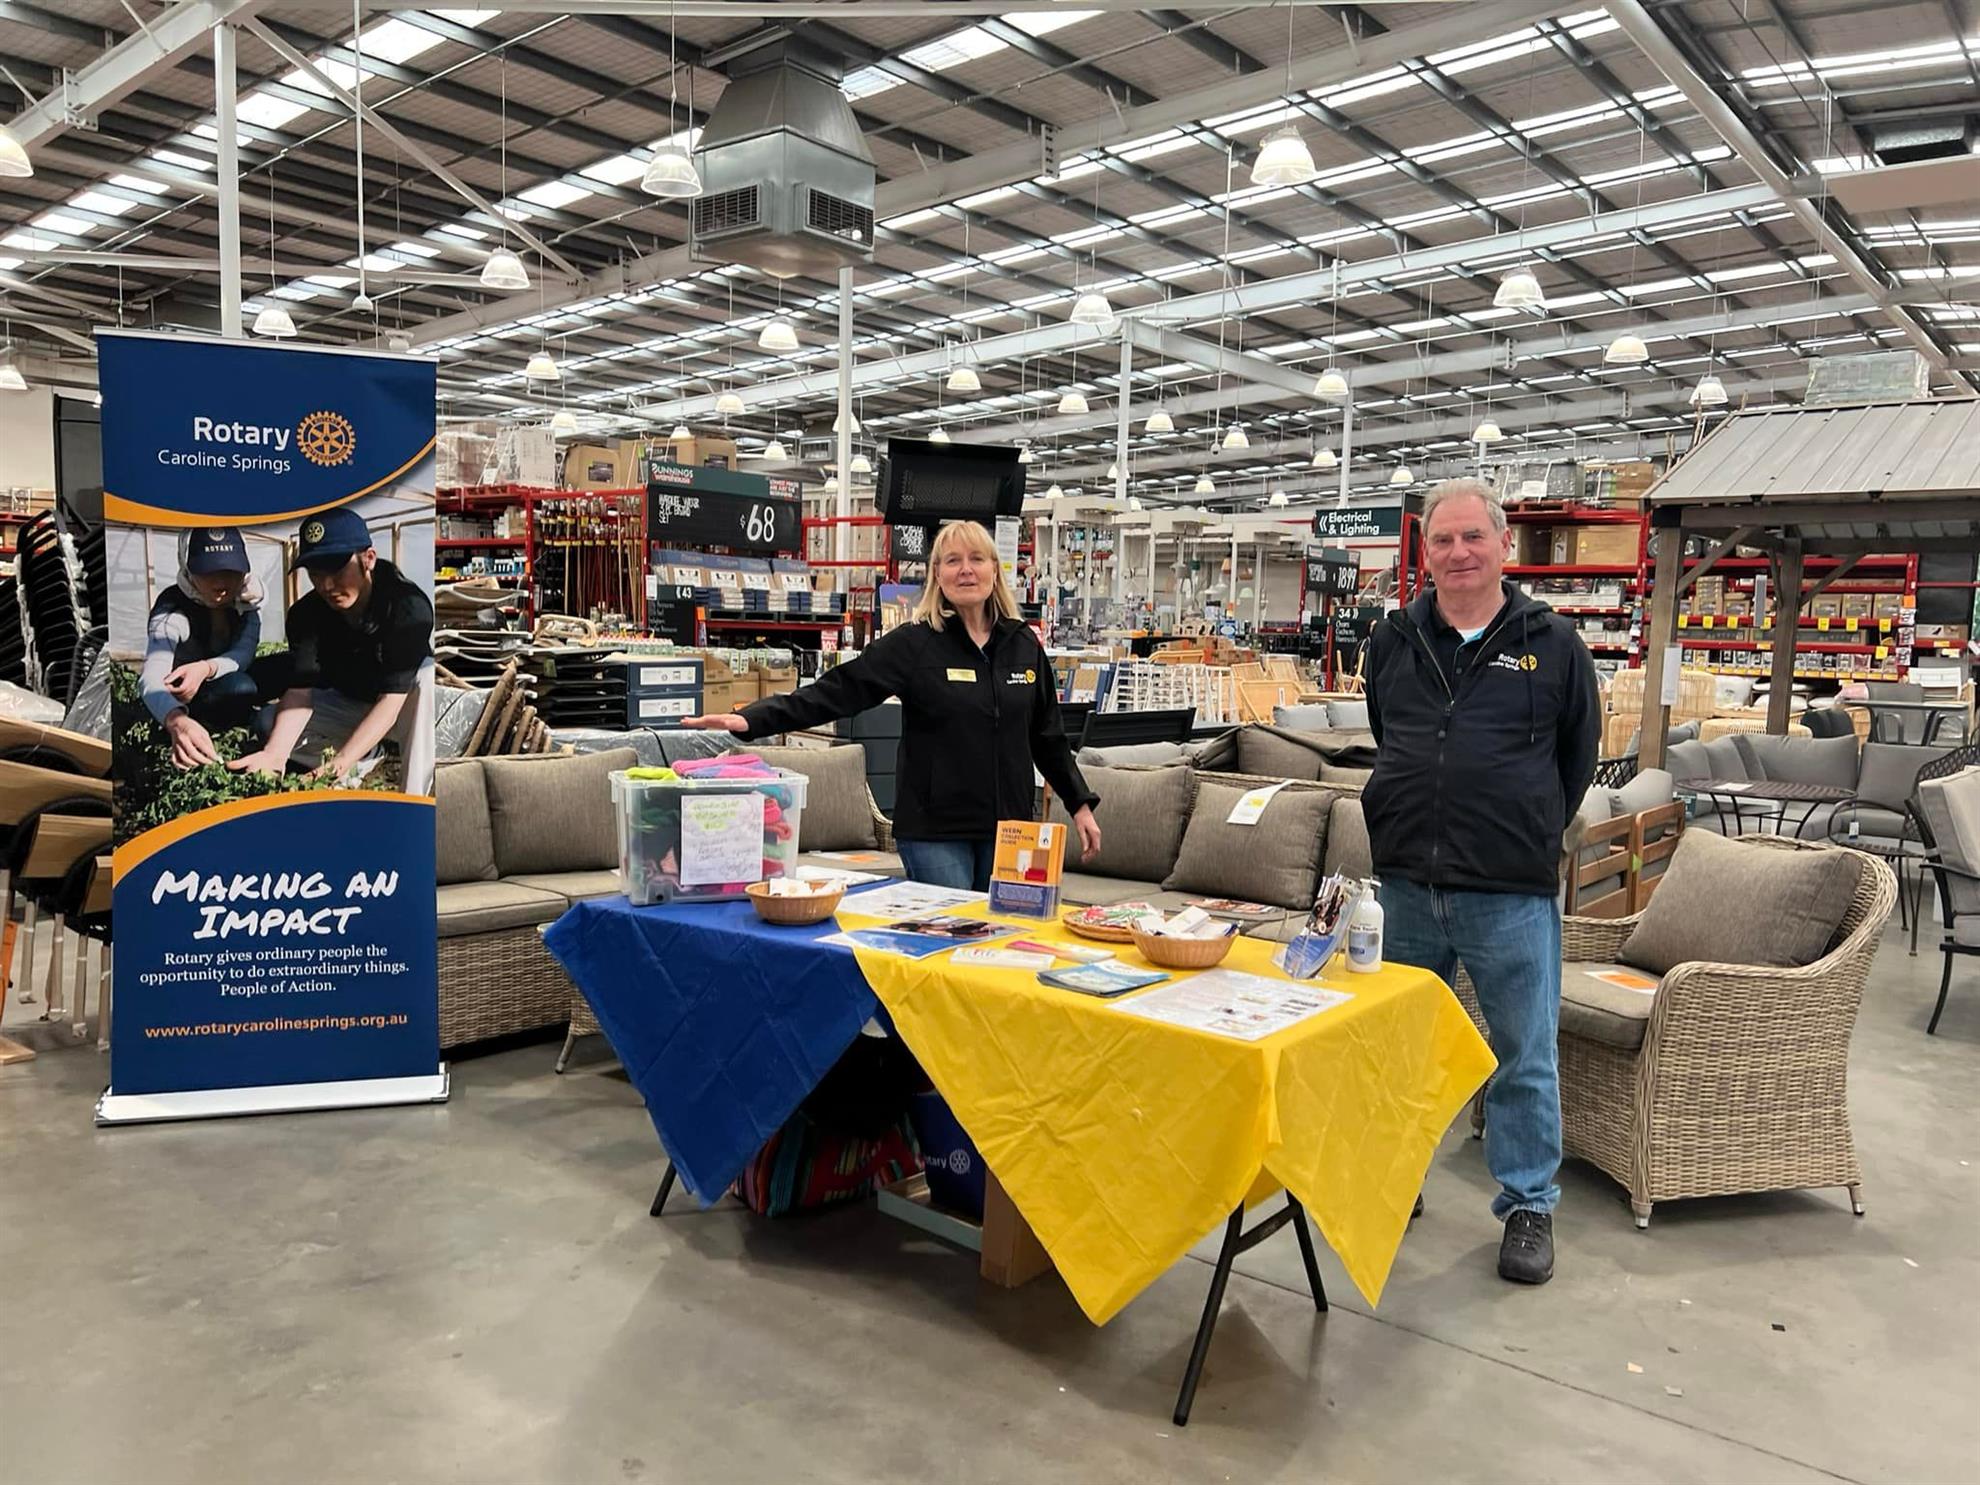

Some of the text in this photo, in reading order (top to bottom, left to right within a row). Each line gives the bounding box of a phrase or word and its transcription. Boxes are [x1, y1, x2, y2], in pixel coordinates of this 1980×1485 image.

[193, 416, 291, 451] Rotary
[157, 449, 291, 474] Caroline Springs
[651, 463, 694, 479] BUNNINGS
[1328, 510, 1372, 523] Electrical
[1328, 522, 1380, 536] & Lighting
[682, 586, 692, 599] 43
[1338, 608, 1351, 619] 34
[152, 870, 399, 905] MAKING AN
[192, 905, 362, 940] IMPACT
[165, 944, 388, 966] Rotary gives ordinary people the
[140, 960, 410, 985] opportunity to do extraordinary things.
[221, 980, 337, 998] People of Action.
[145, 1012, 408, 1038] www.rotarycarolinesprings.org.au
